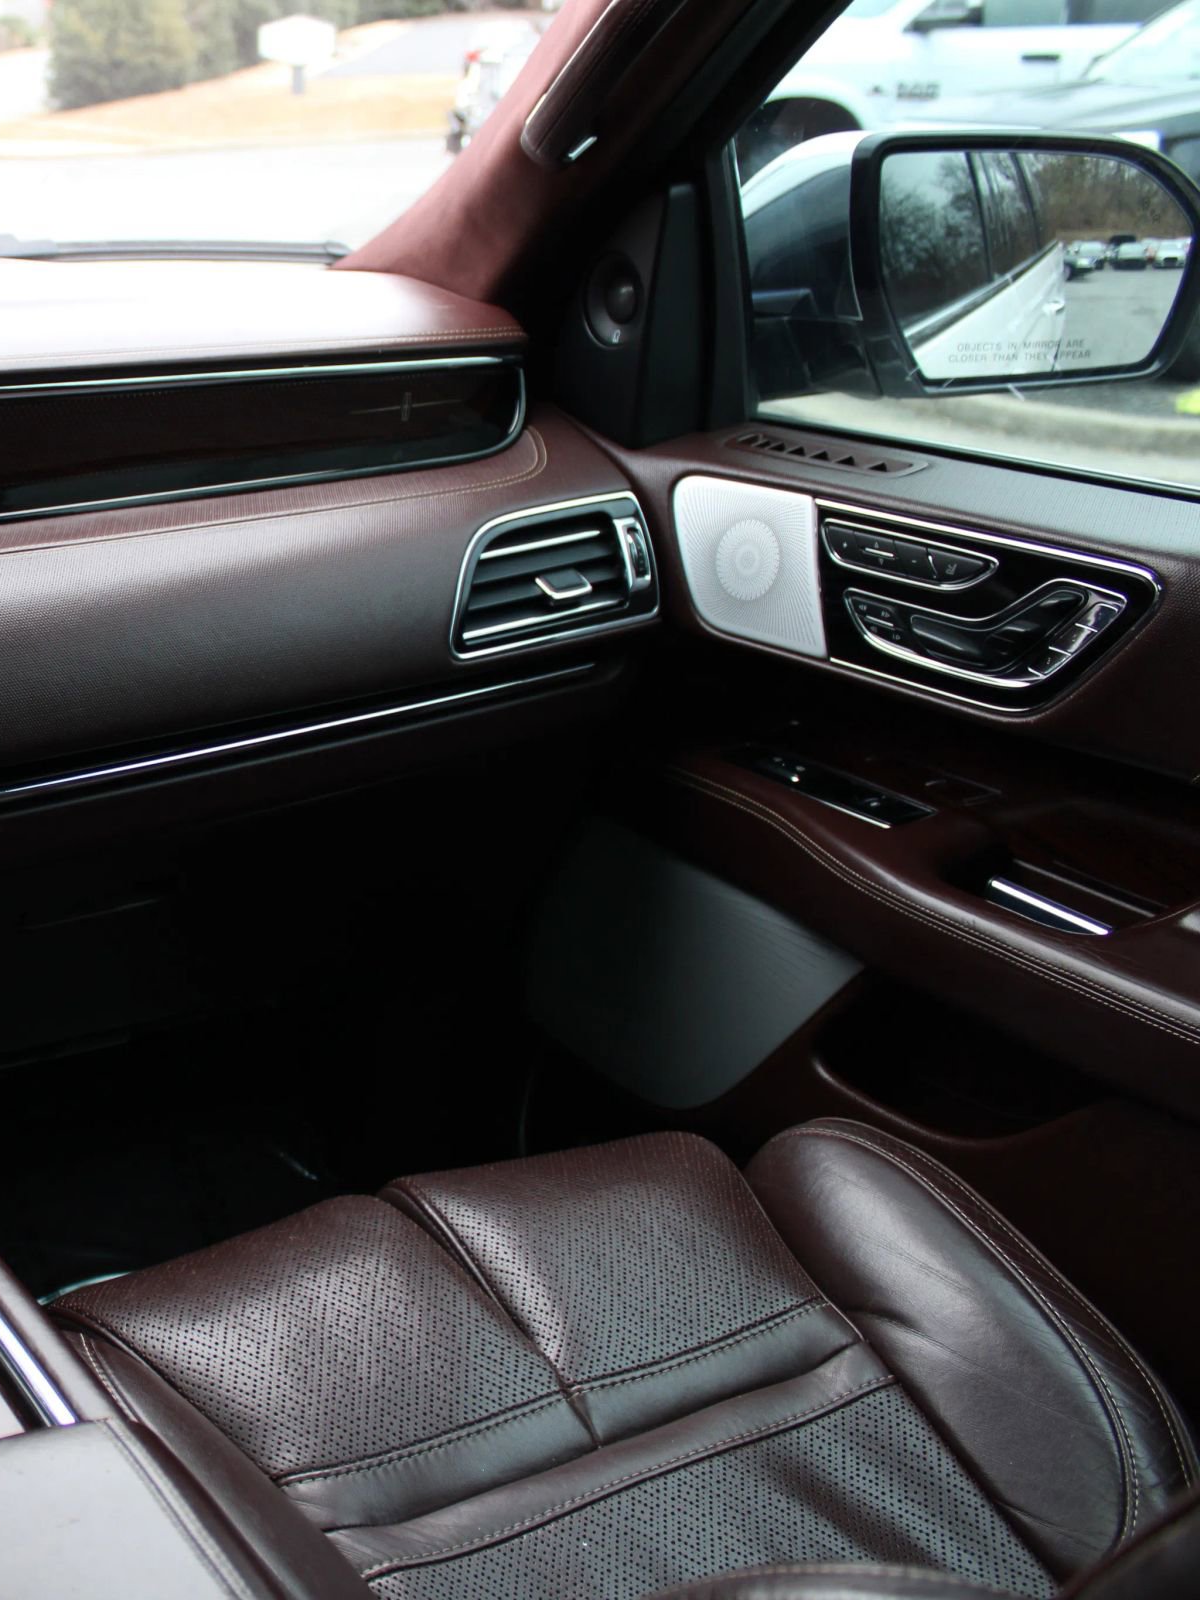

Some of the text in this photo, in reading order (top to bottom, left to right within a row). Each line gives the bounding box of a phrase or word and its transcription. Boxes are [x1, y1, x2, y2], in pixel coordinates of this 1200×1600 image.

[957, 341, 1002, 352] OBJECTS
[1007, 341, 1017, 351] IN
[1065, 338, 1085, 348] ARE
[948, 353, 987, 363] CLOSER
[992, 352, 1018, 362] THAN
[1024, 351, 1048, 361] THEY
